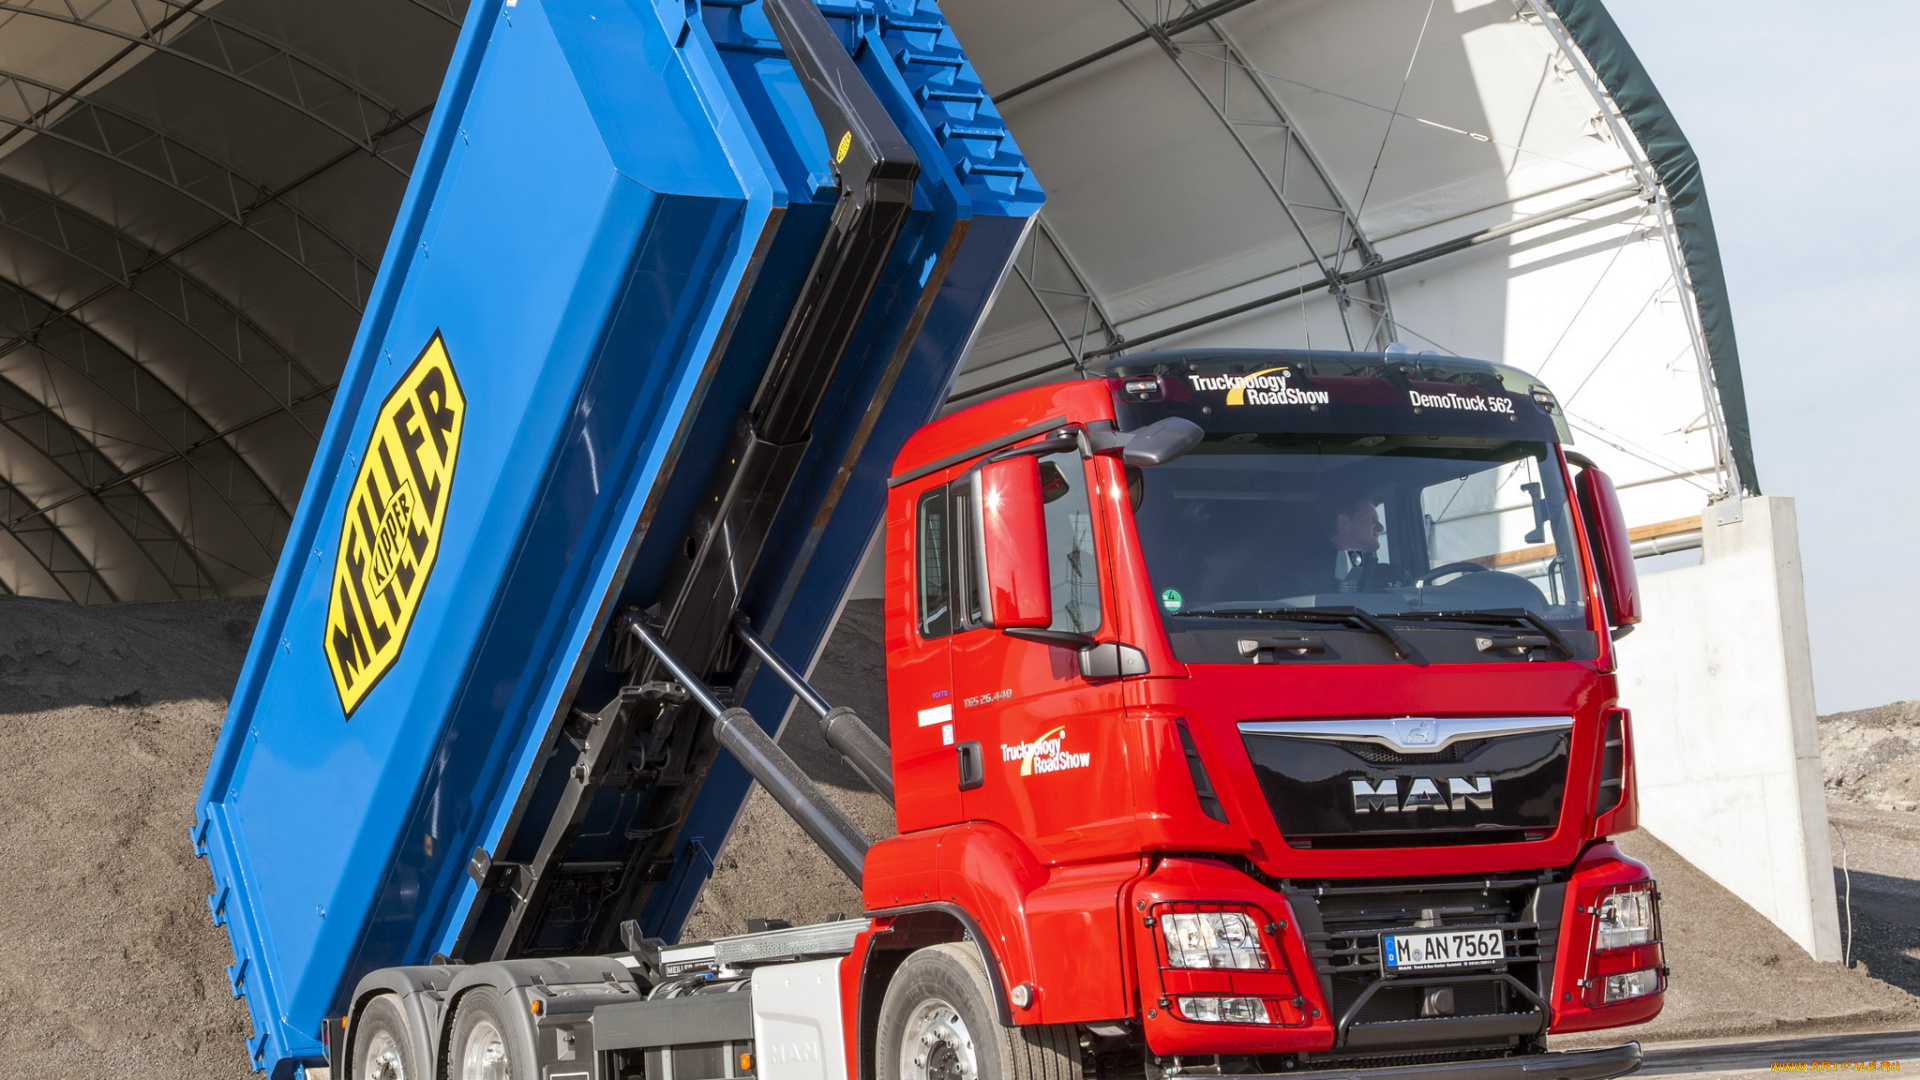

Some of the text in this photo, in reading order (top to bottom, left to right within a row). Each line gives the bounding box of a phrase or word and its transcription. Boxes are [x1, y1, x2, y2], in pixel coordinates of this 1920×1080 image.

[1247, 388, 1329, 405] RoadShow
[1409, 390, 1515, 413] DemoTruck 562
[373, 492, 411, 586] KIPPER
[1168, 591, 1175, 601] 4
[963, 688, 1013, 708] TGS 26.440
[1034, 752, 1090, 774] RoadShow
[1352, 777, 1493, 813] MAN
[1397, 939, 1411, 962] M
[1452, 933, 1501, 958] 7562
[771, 1041, 819, 1064] MAN
